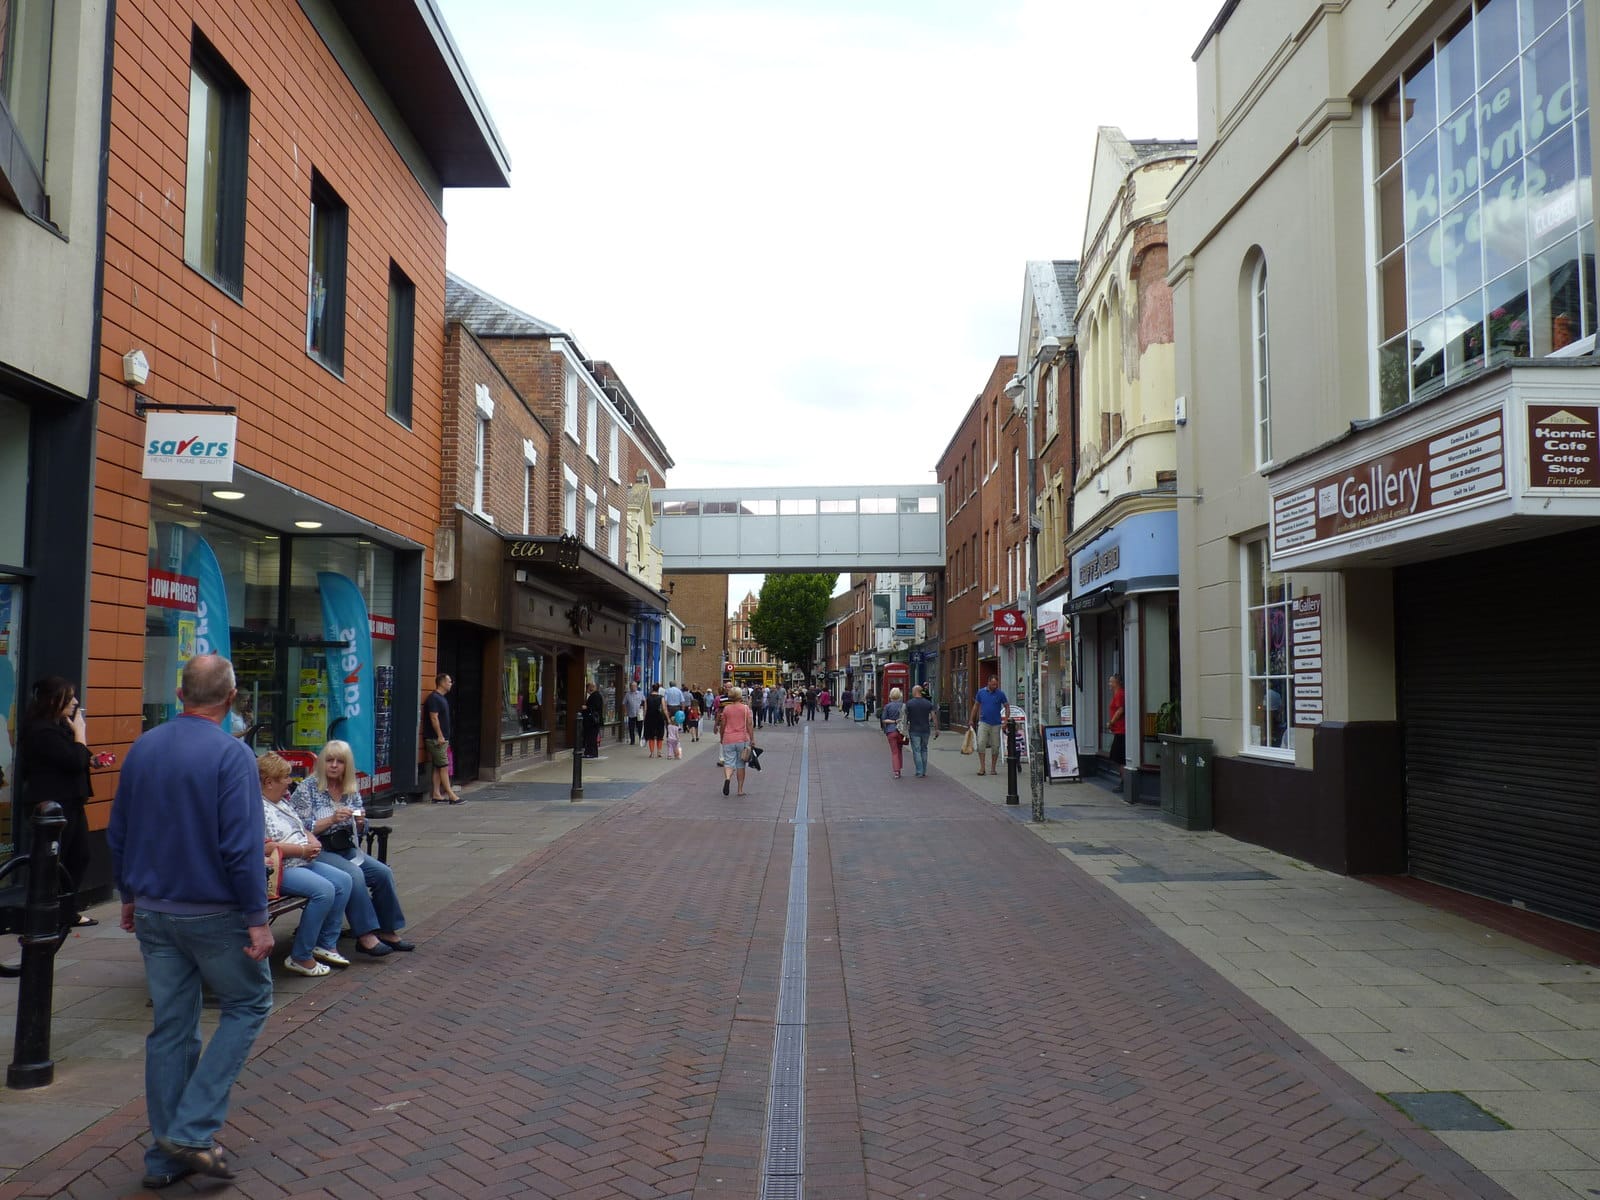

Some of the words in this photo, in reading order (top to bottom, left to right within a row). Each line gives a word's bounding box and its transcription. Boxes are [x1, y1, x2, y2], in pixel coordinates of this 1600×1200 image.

[1448, 87, 1511, 146] The
[1535, 428, 1596, 438] Karmic
[147, 435, 229, 457] savers
[1544, 440, 1587, 451] Cafe
[1541, 453, 1591, 463] Coffee
[1548, 464, 1585, 475] Shop
[1547, 476, 1567, 485] First
[1568, 476, 1592, 485] Floor
[1340, 463, 1423, 519] Gallery
[151, 577, 170, 599] LOW
[170, 581, 197, 604] PRICES
[1299, 597, 1320, 613] Gallery
